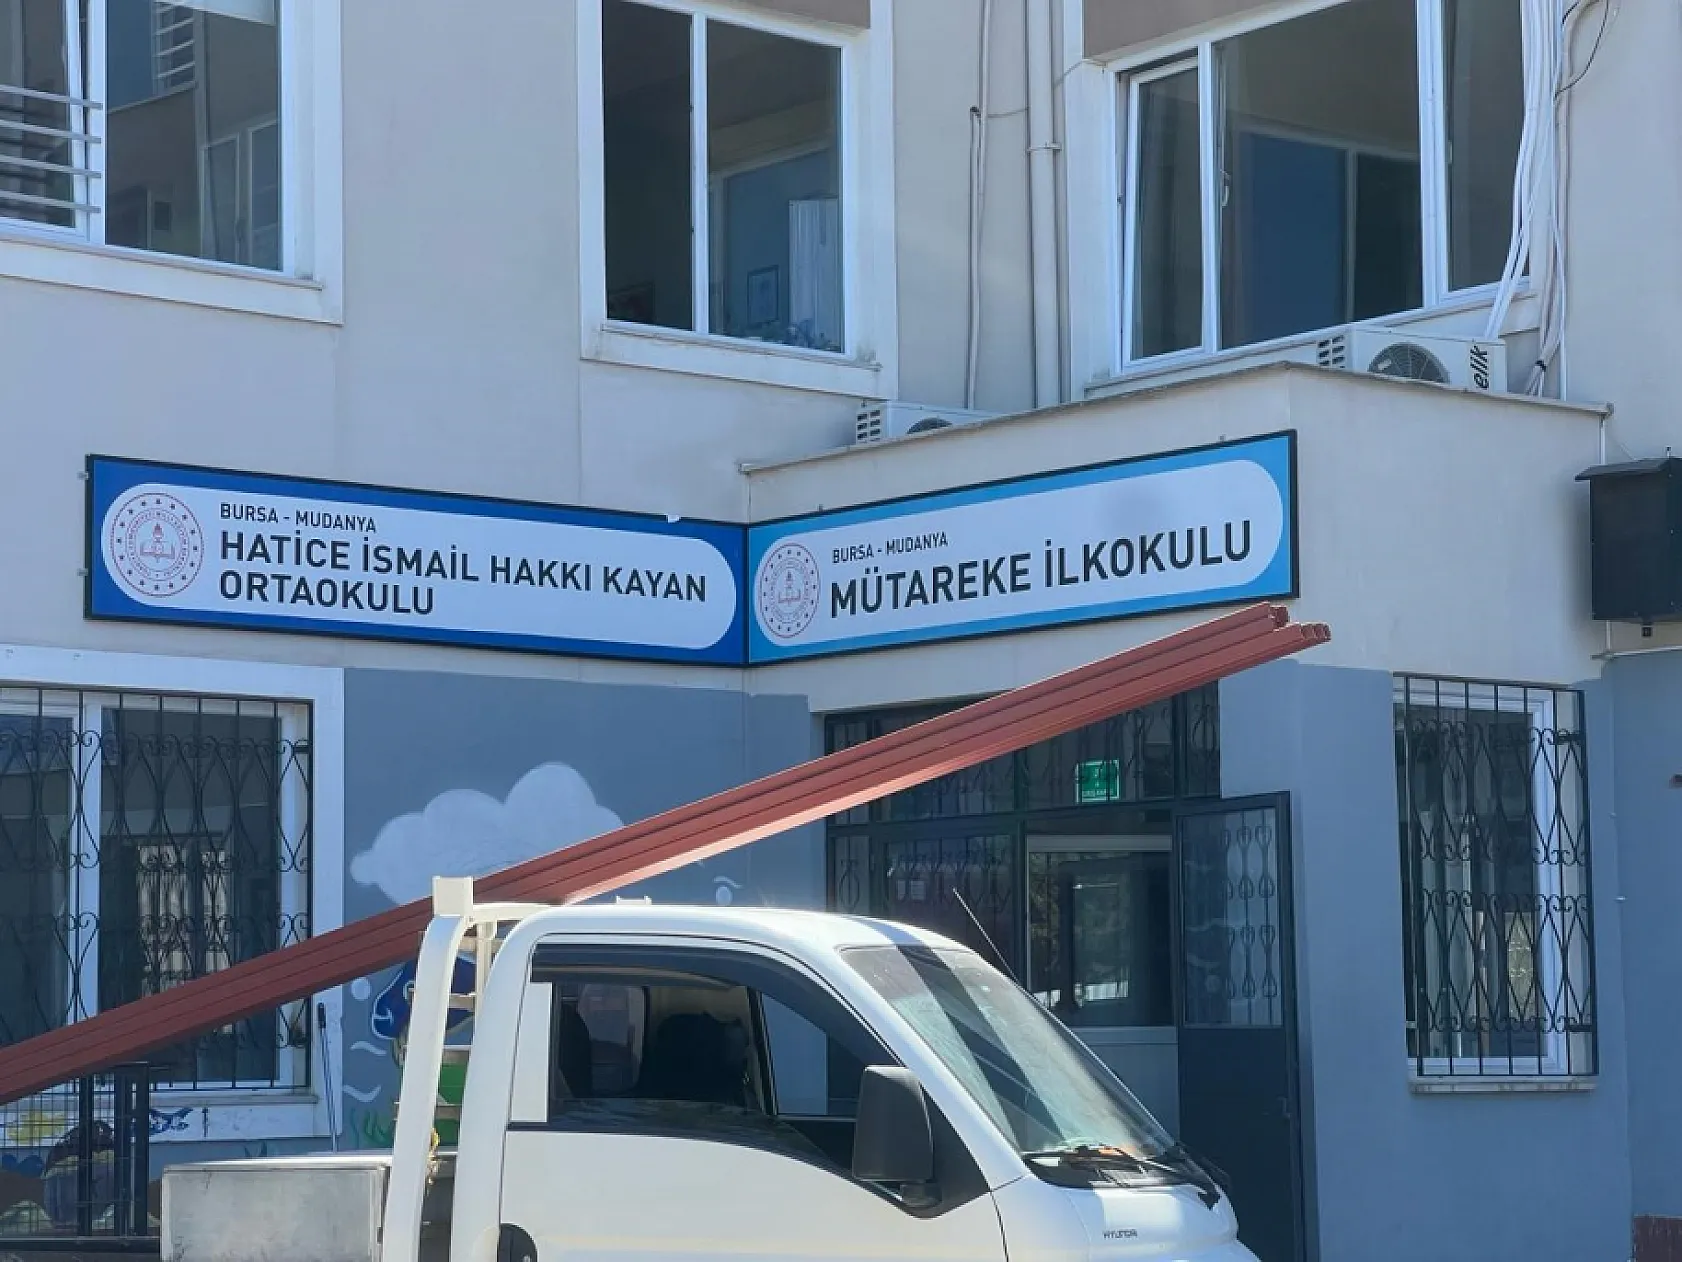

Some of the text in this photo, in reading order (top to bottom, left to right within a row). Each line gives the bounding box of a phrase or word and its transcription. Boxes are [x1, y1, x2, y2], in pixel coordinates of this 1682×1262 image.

[220, 502, 279, 523] BURSA
[295, 510, 377, 533] MUDANYA
[220, 529, 350, 570] HATİCE
[362, 536, 479, 582] İSMAİL
[489, 554, 591, 592] HAKKI
[603, 566, 706, 602] KAYAN
[831, 553, 1031, 619] MÜTAREKE
[1045, 519, 1251, 588] İLKOKULU
[833, 543, 874, 564] BURSA
[886, 531, 948, 555] MUDANYA
[220, 569, 434, 615] ORTAOKULU
